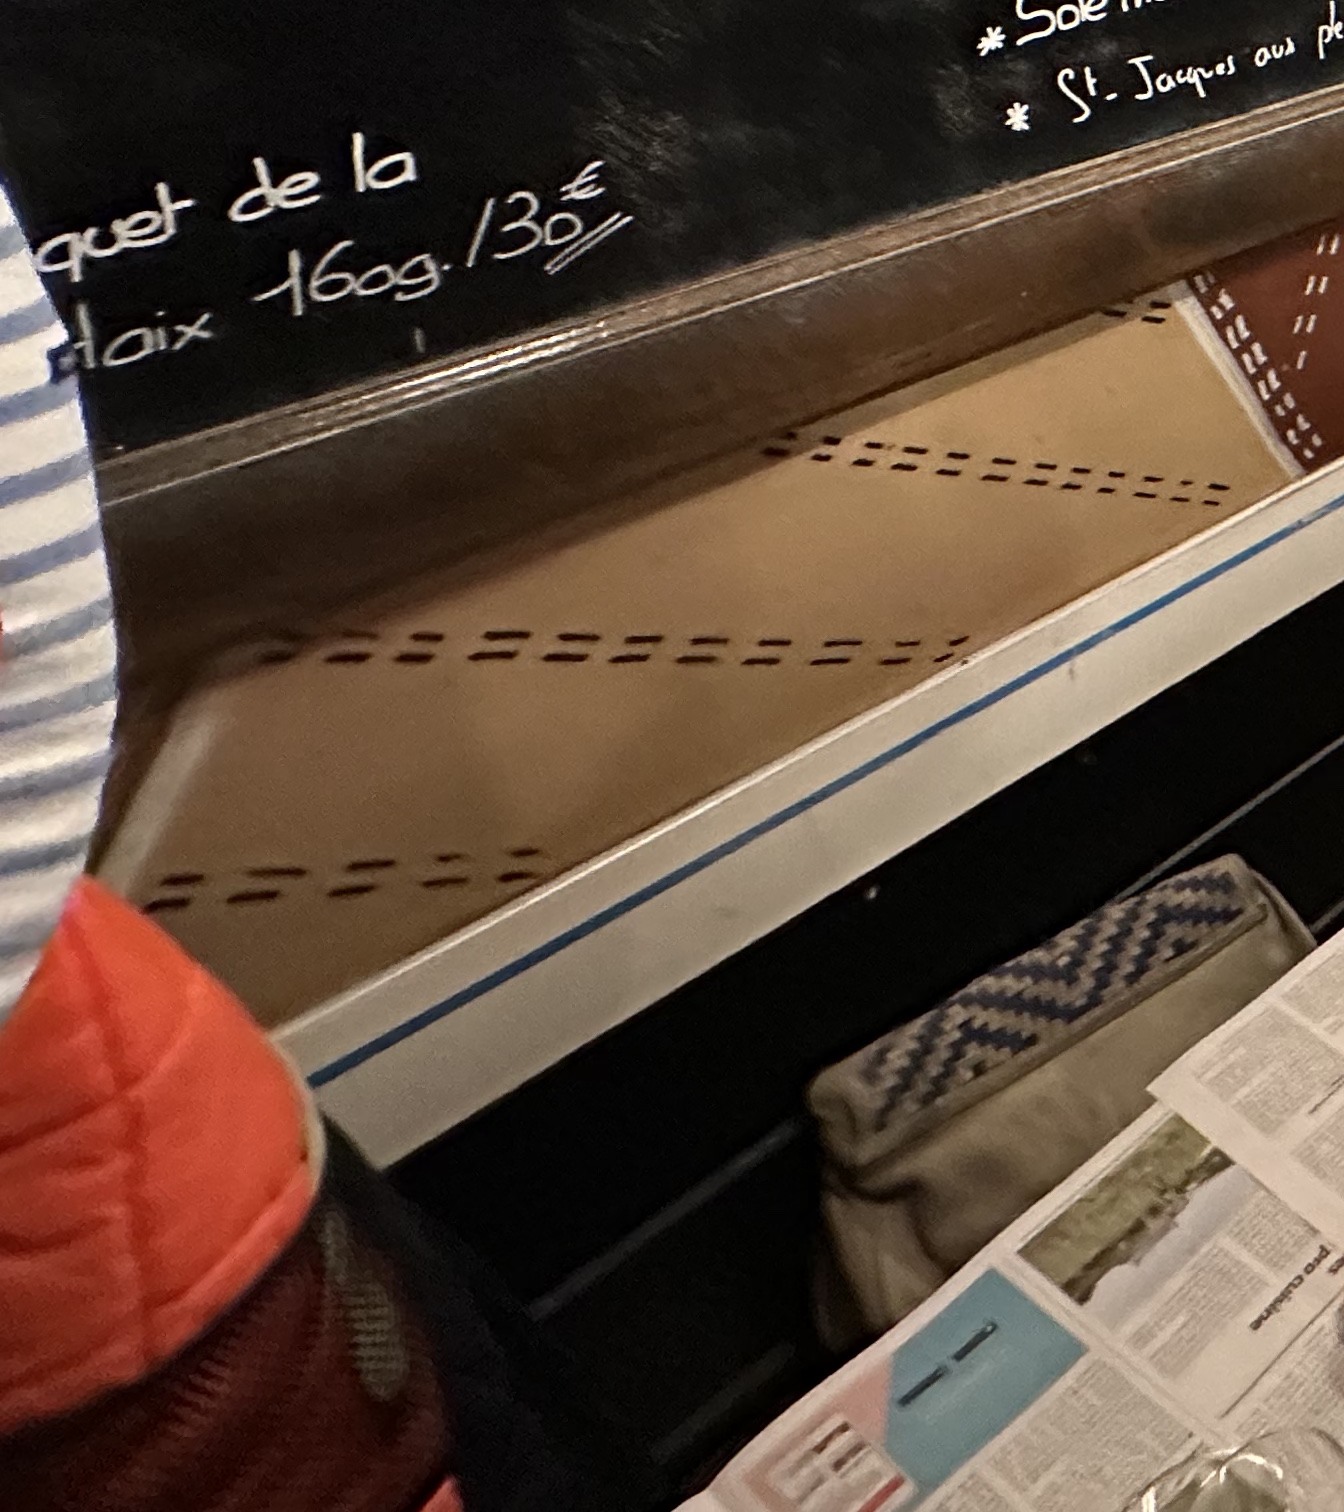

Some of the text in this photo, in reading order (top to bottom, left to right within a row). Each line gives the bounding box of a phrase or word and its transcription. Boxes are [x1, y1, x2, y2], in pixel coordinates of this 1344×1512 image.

[228, 156, 322, 224] de
[350, 131, 418, 193] la
[1249, 1244, 1333, 1331] pro cuisine
